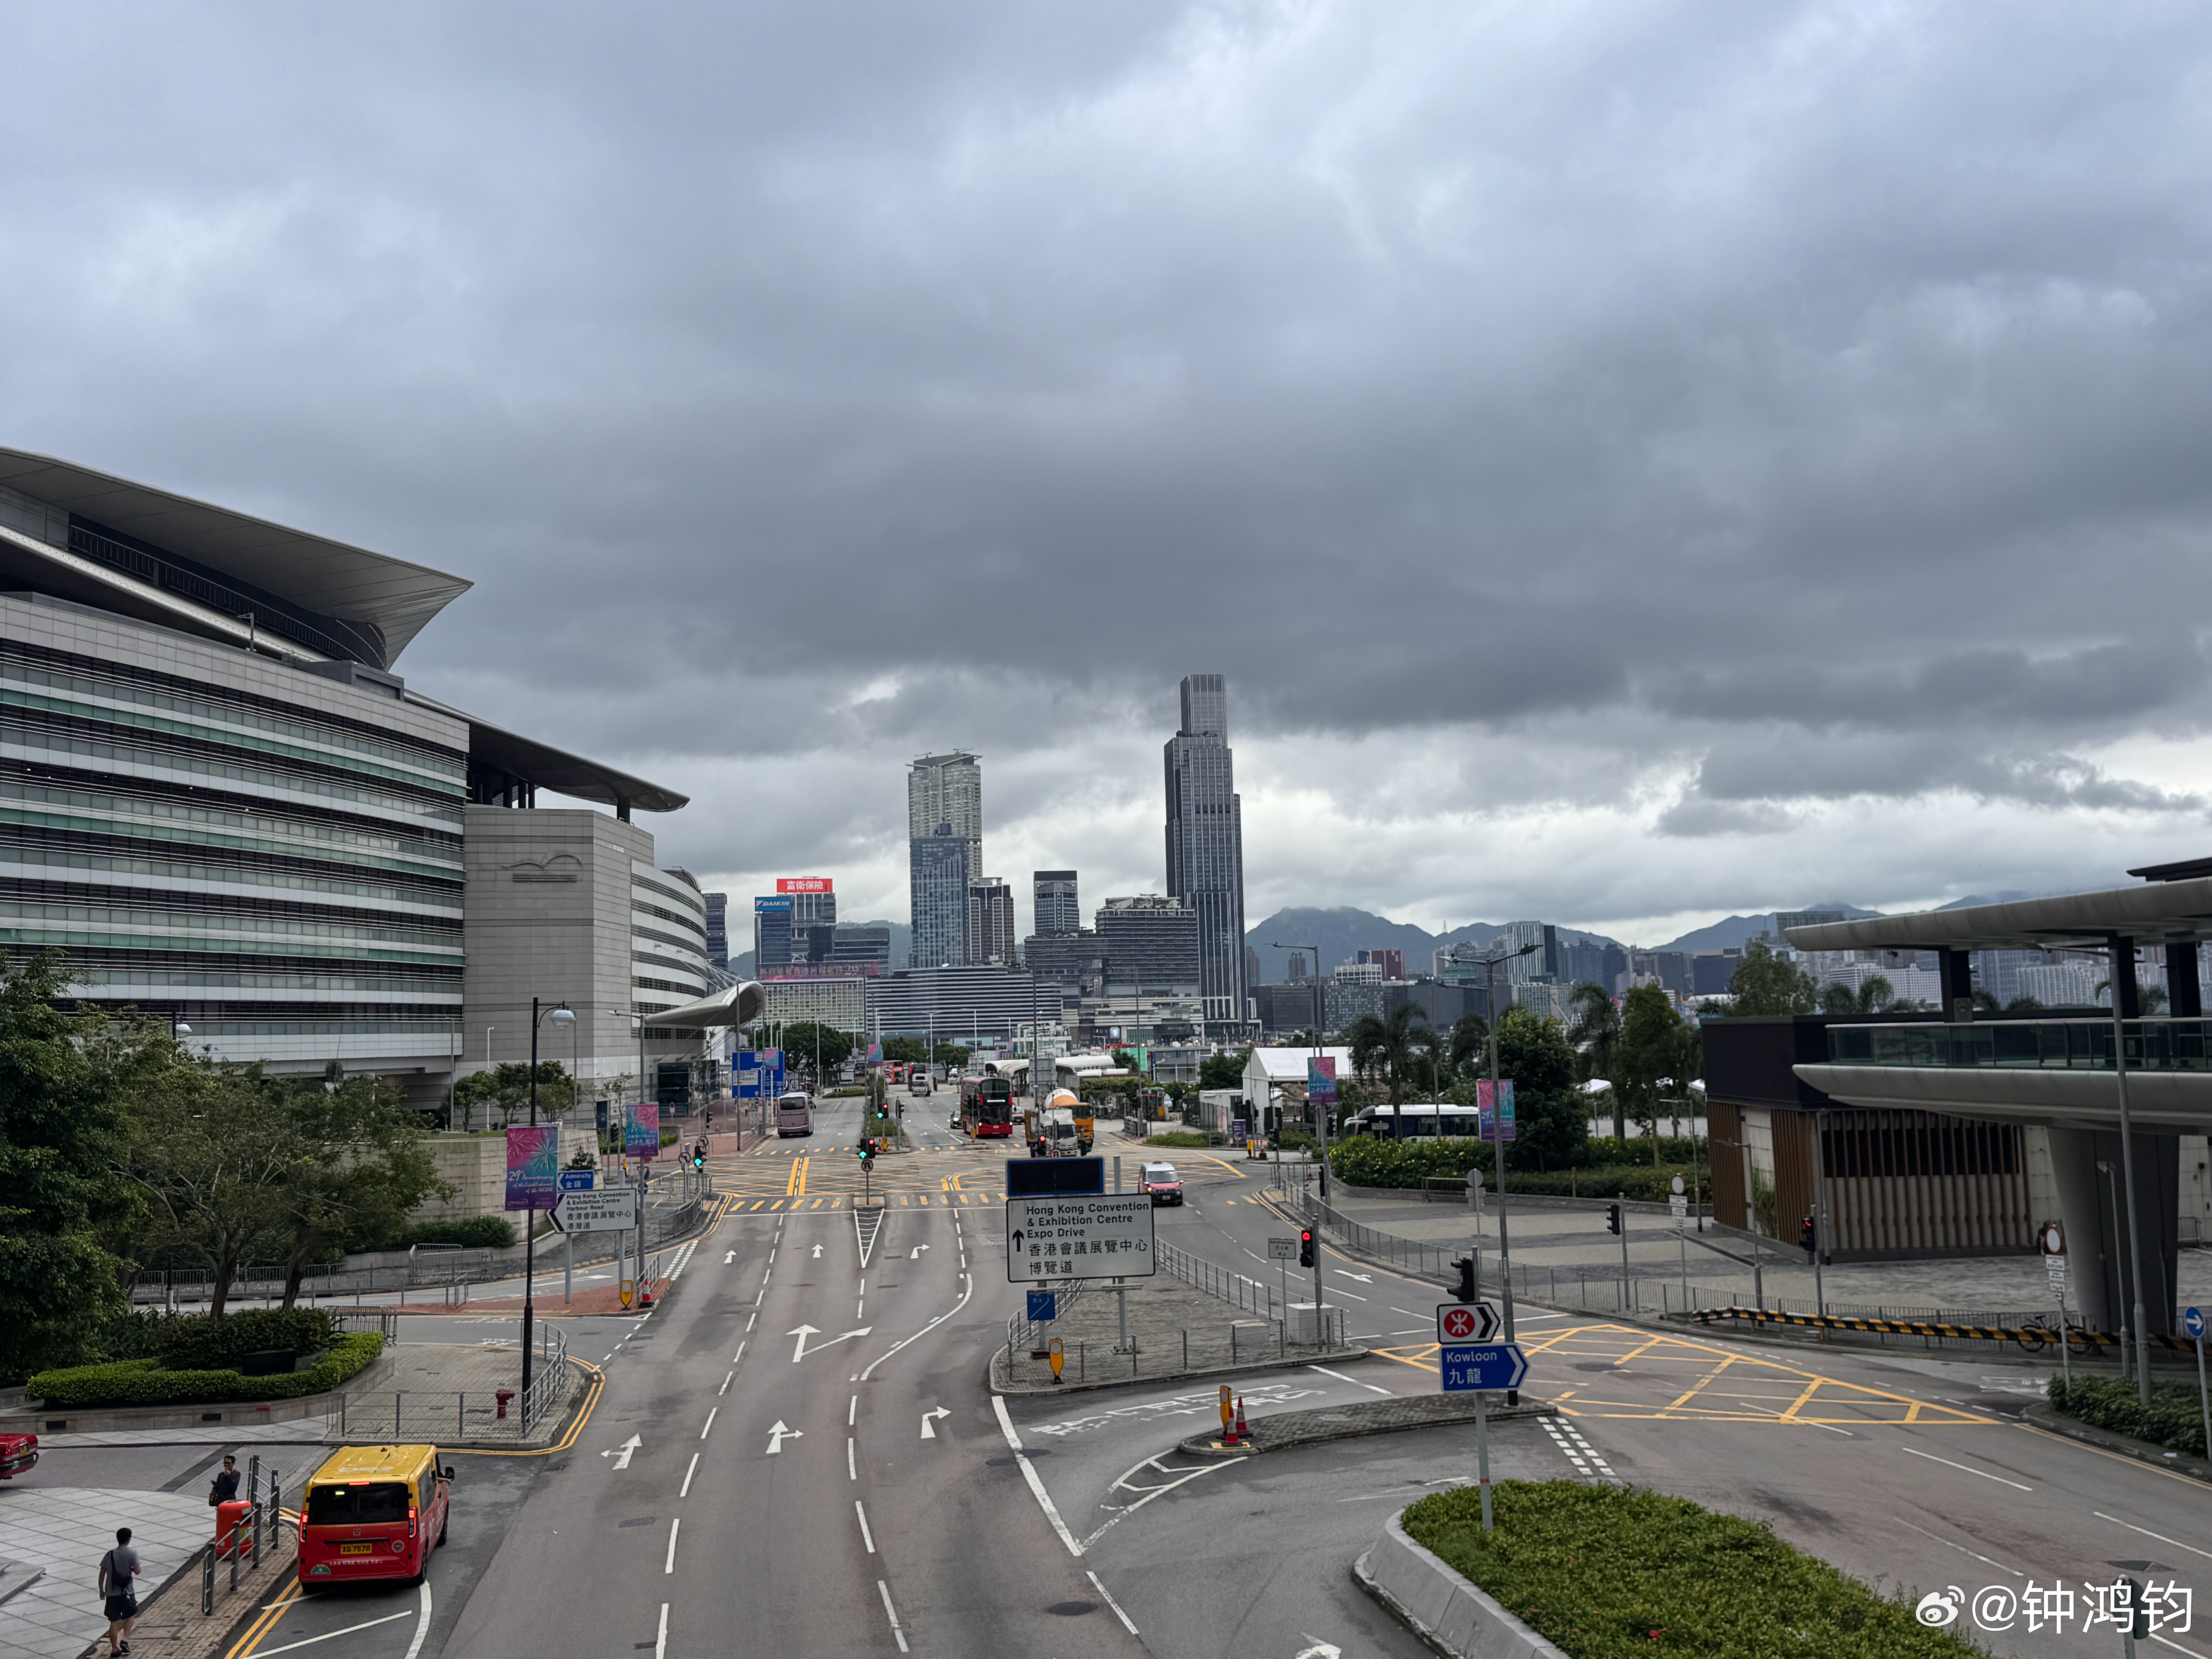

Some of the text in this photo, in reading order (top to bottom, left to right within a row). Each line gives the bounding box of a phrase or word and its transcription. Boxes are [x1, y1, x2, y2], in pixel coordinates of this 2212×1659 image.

[787, 881, 823, 890] 富衛保險
[1027, 1202, 1149, 1216] Hong Kong Convention
[567, 1211, 632, 1220] 香港會議展覽中心
[1039, 1217, 1092, 1226] Exhibition
[1097, 1214, 1133, 1224] Centre
[567, 1222, 590, 1230] 港灣道
[1027, 1228, 1085, 1239] Expo Drive
[1029, 1239, 1148, 1257] 香港會議展覽中心
[1029, 1260, 1073, 1275] 博覽道
[1446, 1351, 1497, 1363] Kowloon
[1449, 1368, 1482, 1385] 九龍
